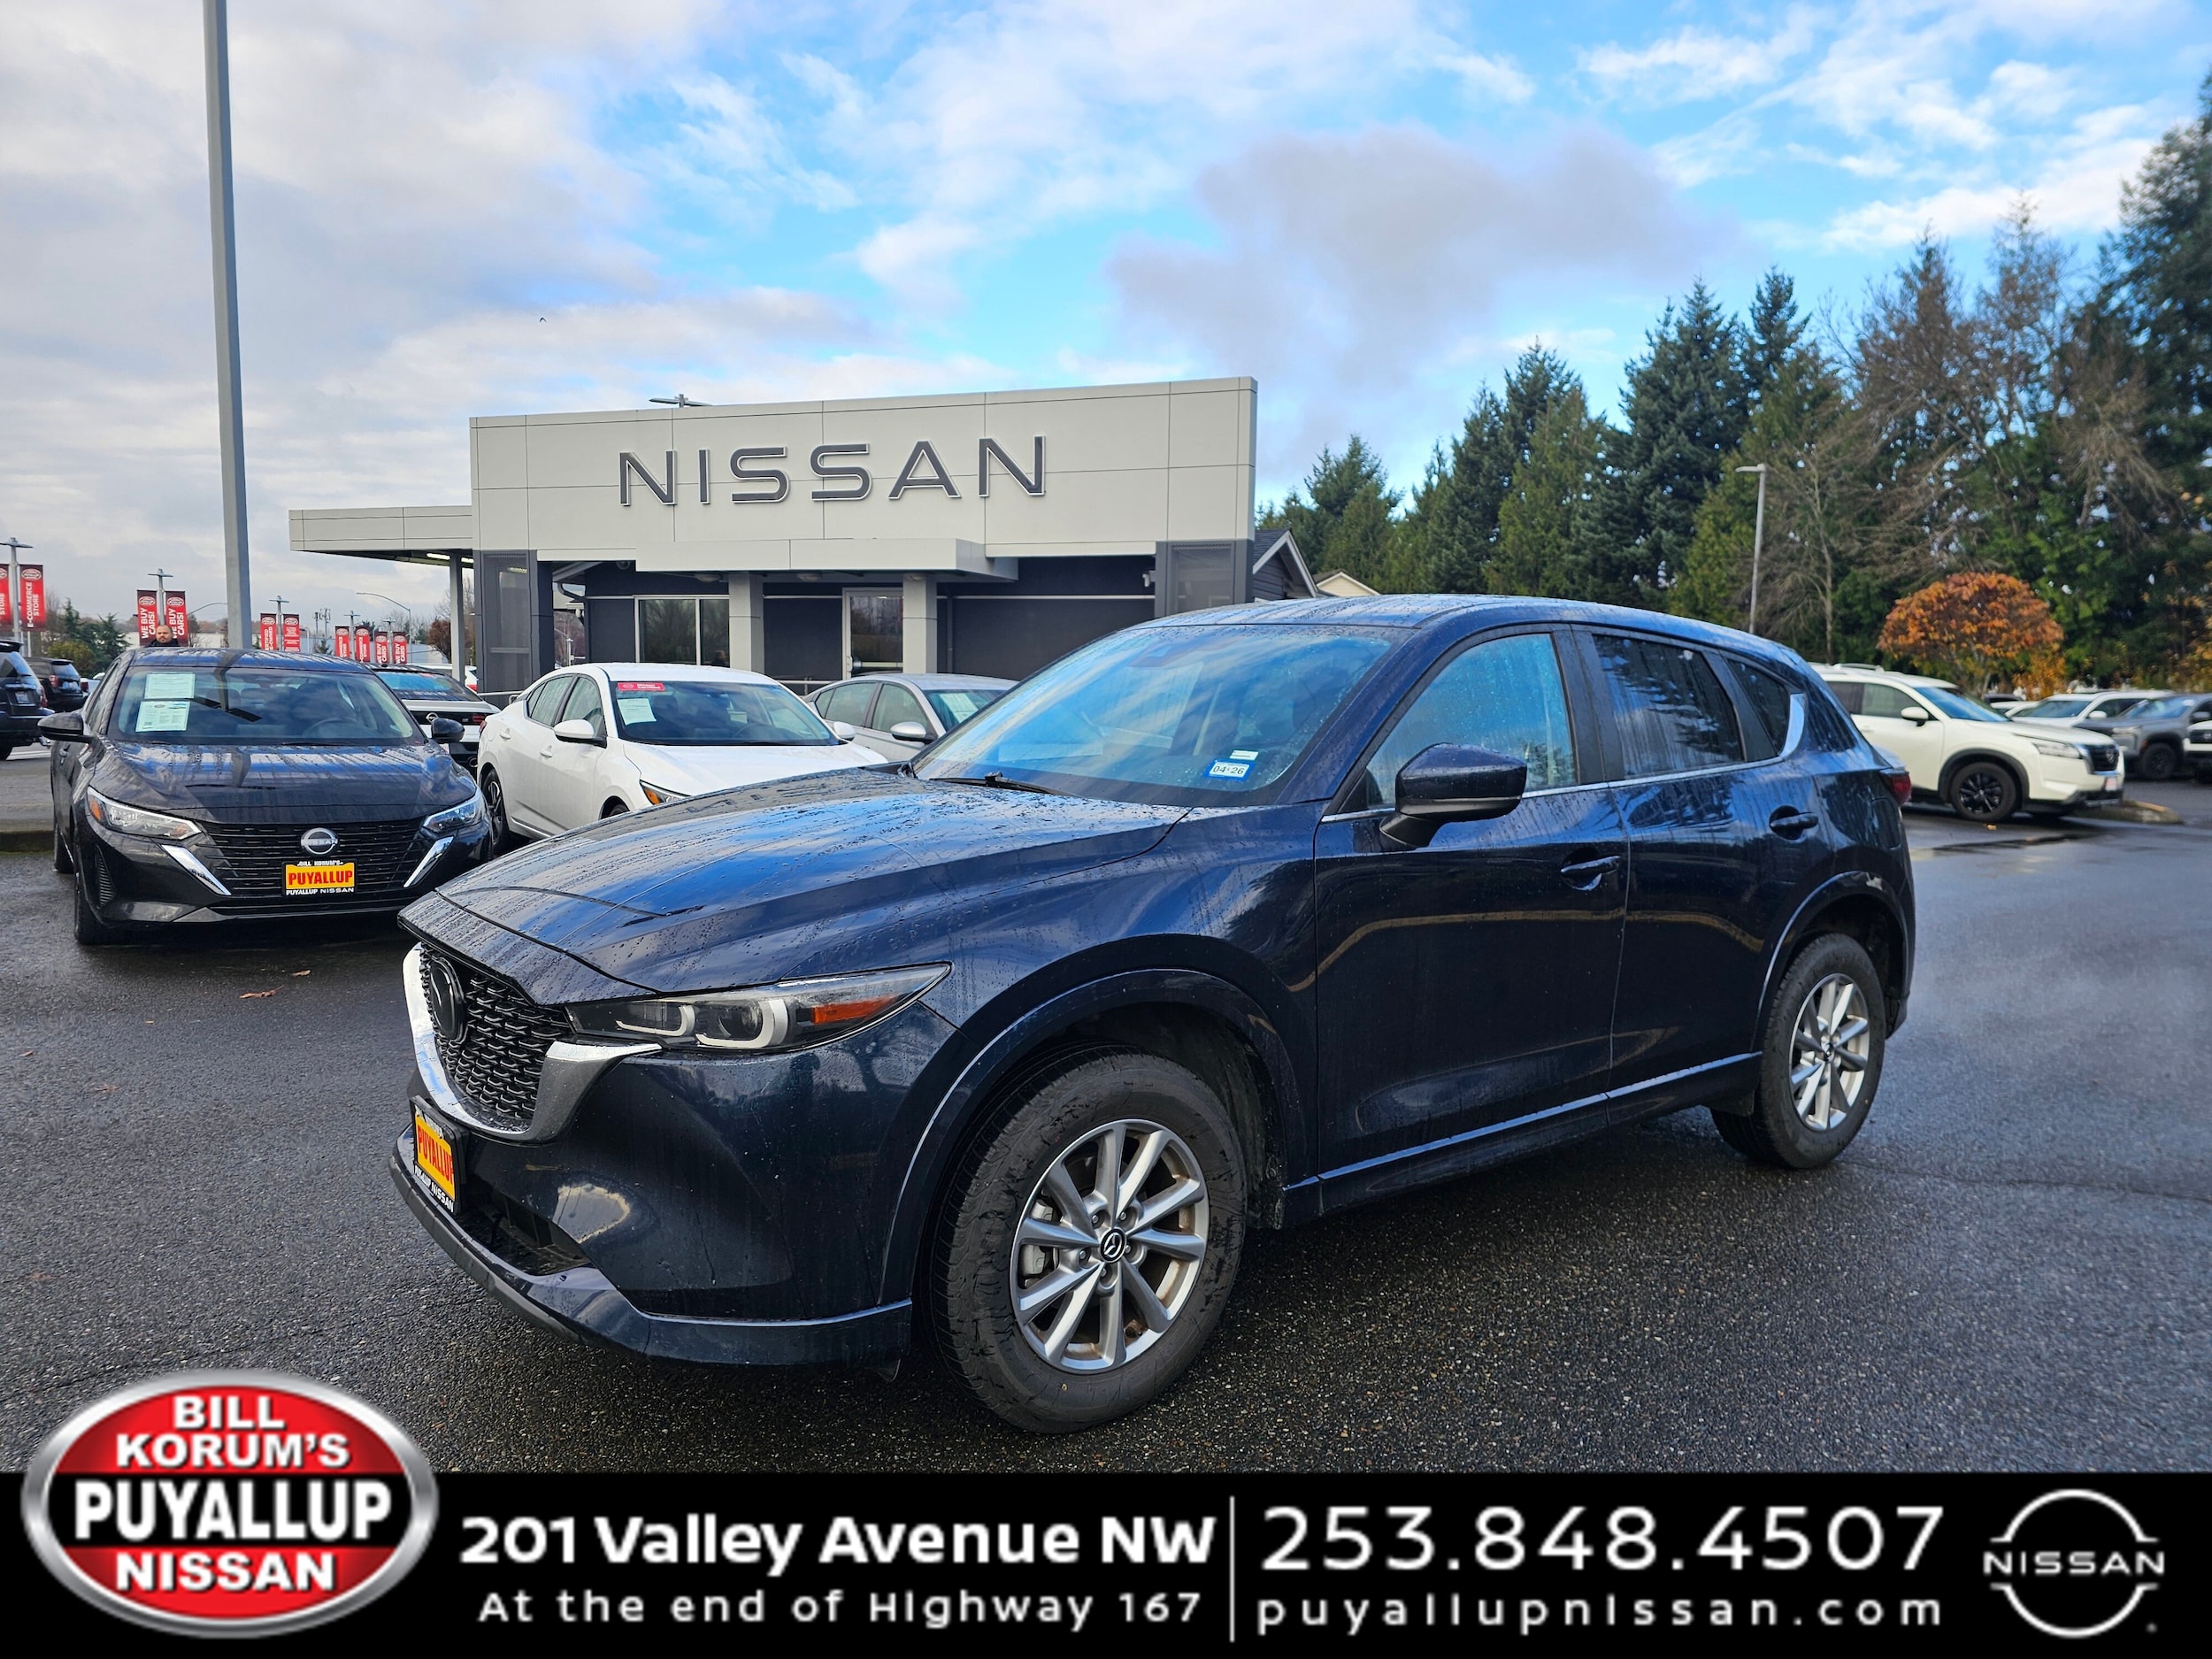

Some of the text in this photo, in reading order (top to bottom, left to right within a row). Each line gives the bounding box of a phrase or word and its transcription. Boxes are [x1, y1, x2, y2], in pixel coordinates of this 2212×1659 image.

[618, 434, 1046, 507] NISSAN
[142, 626, 149, 639] WE
[288, 871, 353, 885] PUYALLUP
[417, 1124, 454, 1185] PUYALLUP
[431, 1182, 454, 1213] NISSAN
